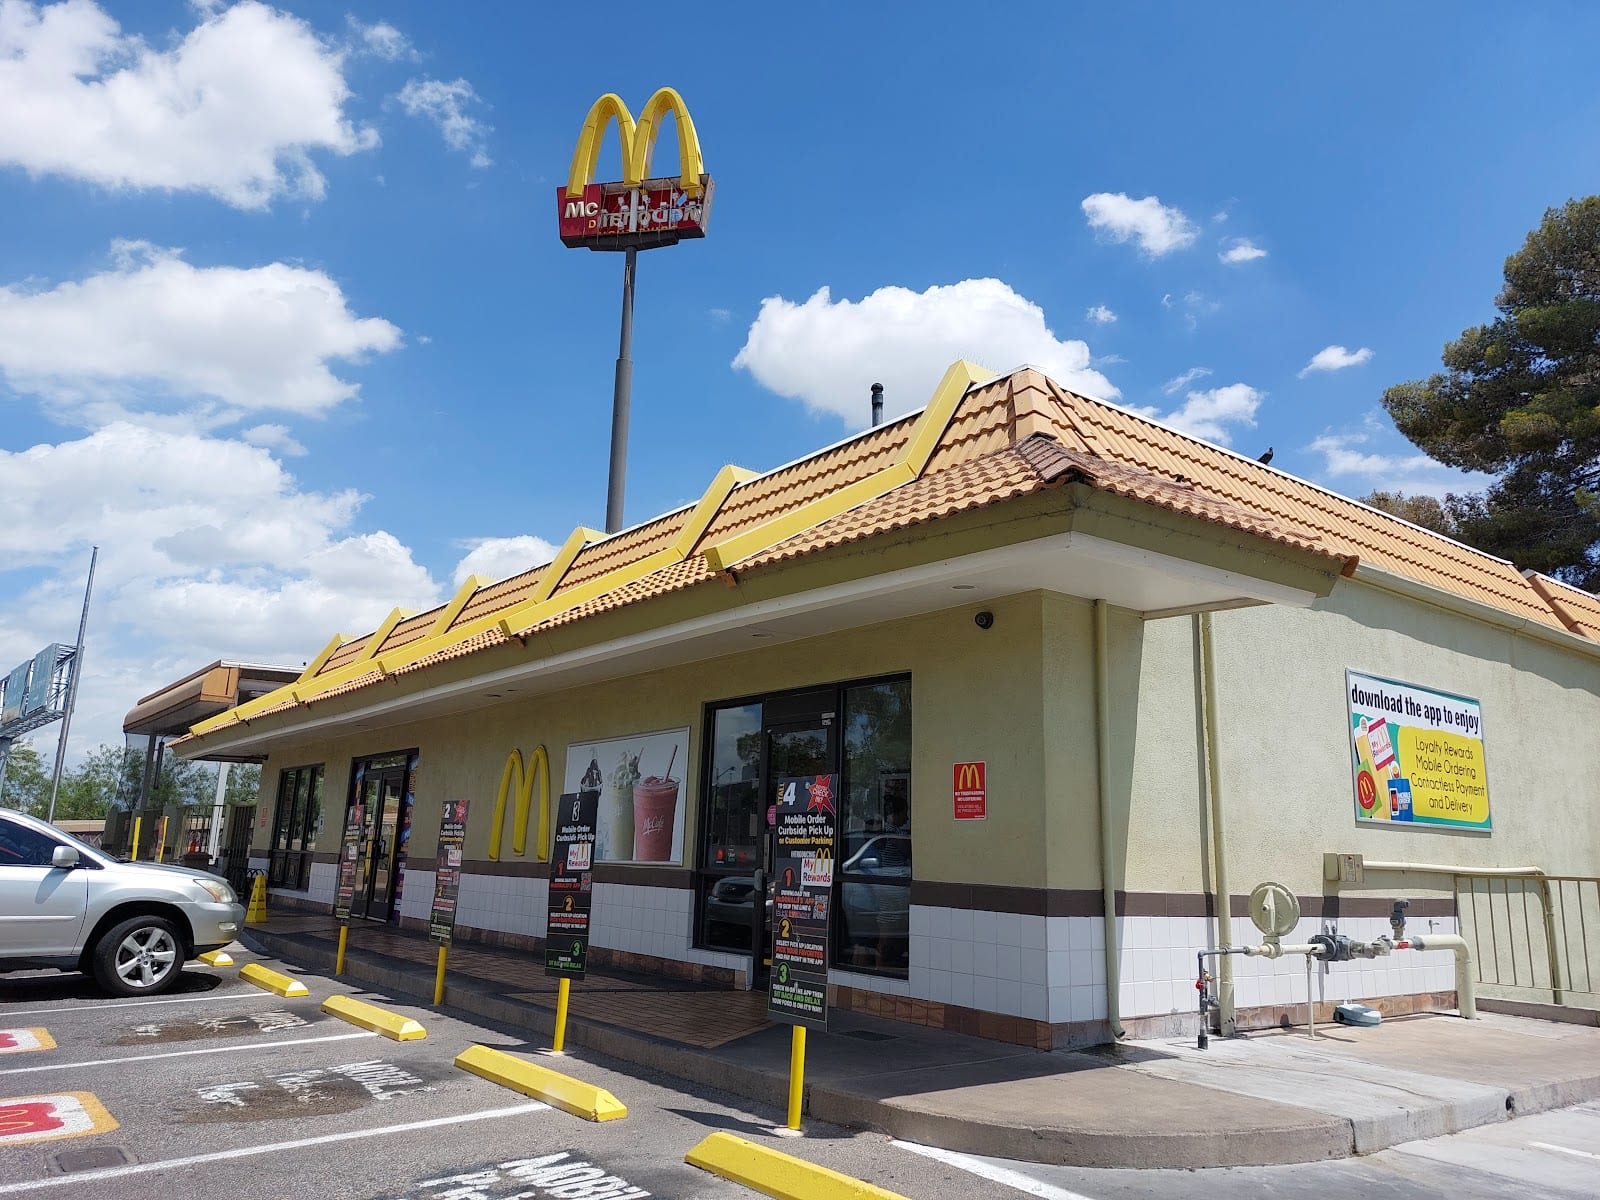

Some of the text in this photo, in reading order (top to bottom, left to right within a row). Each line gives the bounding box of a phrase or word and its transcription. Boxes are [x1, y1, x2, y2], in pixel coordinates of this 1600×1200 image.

[1351, 683, 1479, 734] download the app to enjoy
[1415, 736, 1474, 760] Loyalty Rewards
[1416, 755, 1476, 780] Mobile Ordering
[1411, 772, 1485, 797] Contactless Payment
[783, 782, 796, 806] 4
[444, 804, 450, 818] 2
[1429, 796, 1444, 810] and
[1445, 796, 1472, 815] Delivery
[784, 814, 806, 824] Mobile
[807, 814, 826, 824] Order
[778, 825, 834, 837] Curbside Pick Up
[811, 837, 833, 845] Parking
[804, 859, 814, 871] My
[785, 869, 792, 888] 1
[803, 872, 831, 883] Rewards
[565, 897, 572, 911] 2
[781, 919, 790, 937] 2
[573, 943, 580, 956] 3
[780, 964, 787, 983] 3
